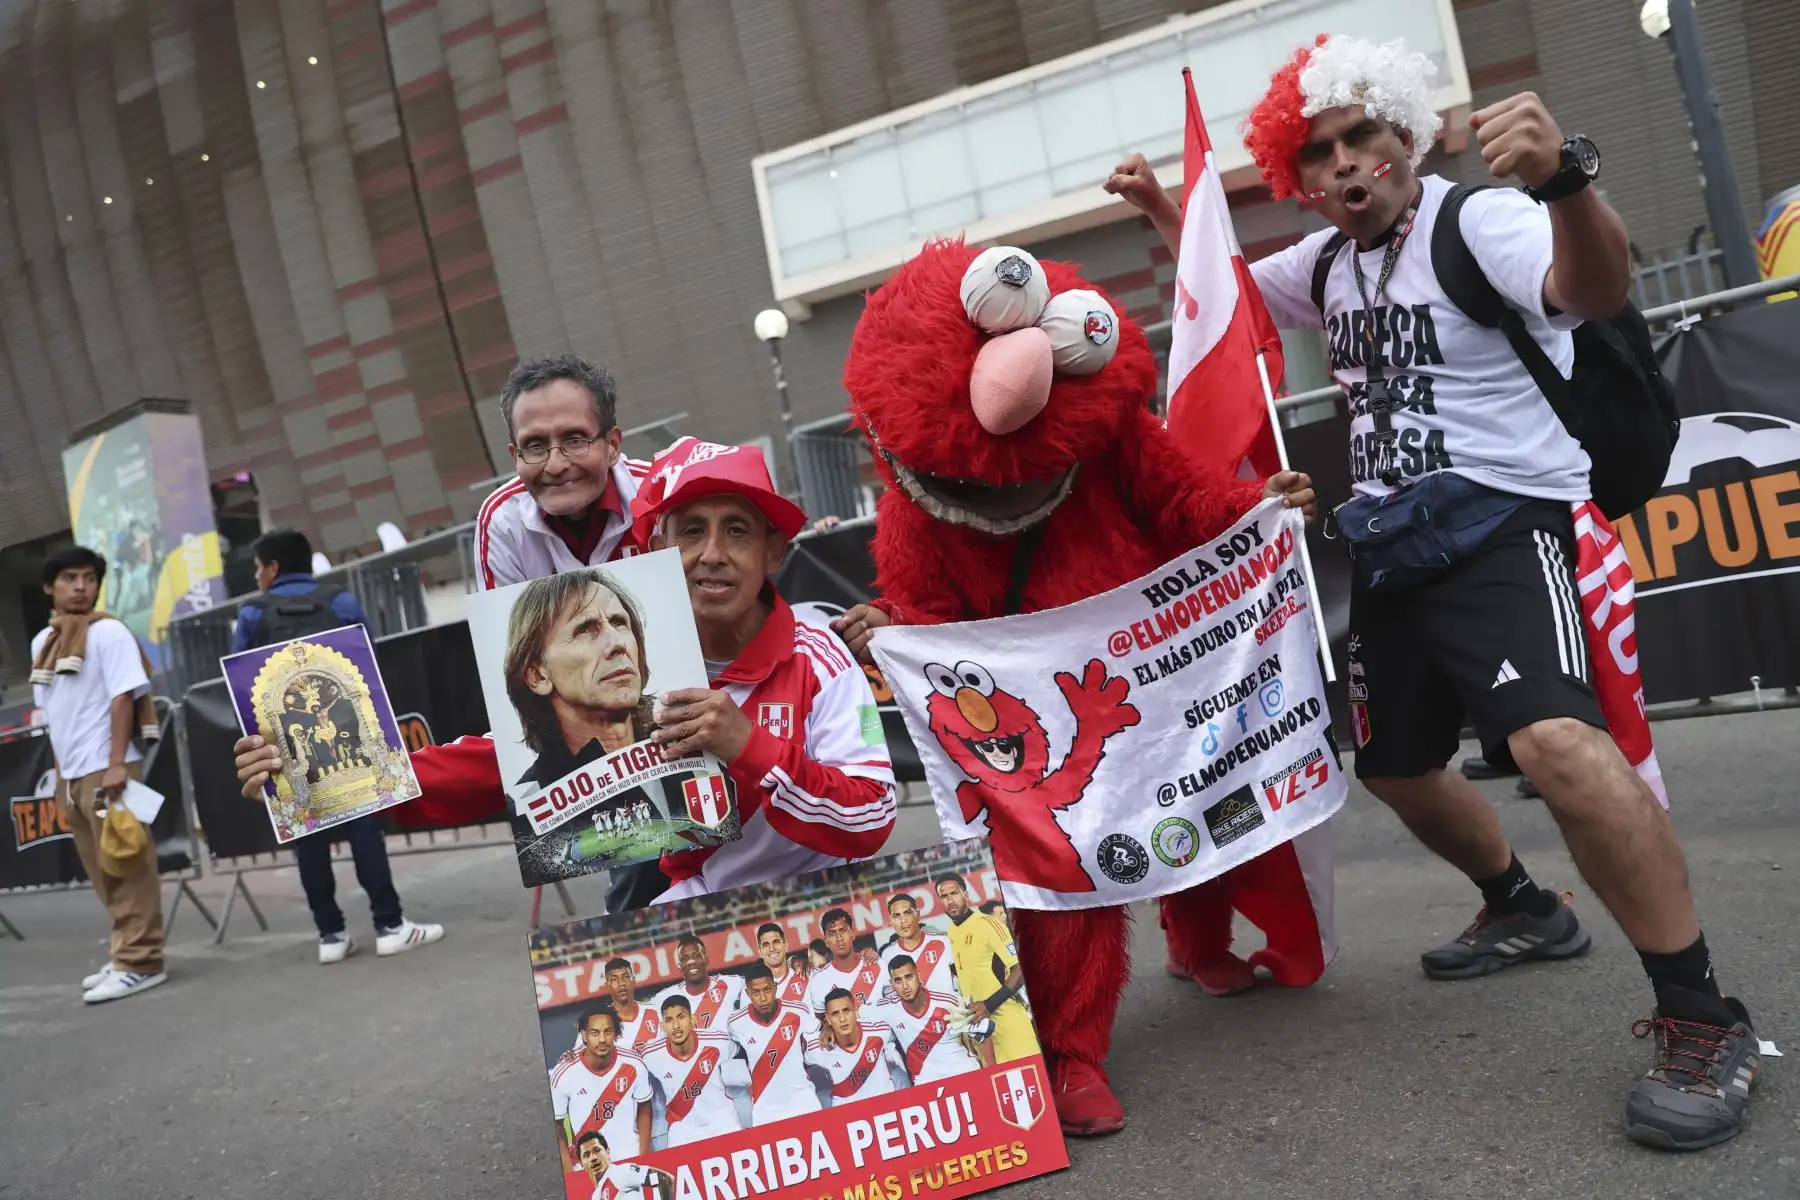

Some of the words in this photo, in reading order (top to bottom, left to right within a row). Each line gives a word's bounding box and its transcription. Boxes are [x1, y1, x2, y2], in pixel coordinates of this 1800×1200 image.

[1350, 428, 1454, 483] GRESA
[1141, 558, 1219, 608] HOLA
[1215, 520, 1264, 567] SOY
[1132, 664, 1158, 687] EL
[1156, 643, 1193, 678] MÁS
[1191, 619, 1237, 659] DURO
[1236, 604, 1258, 634] EN
[1257, 596, 1278, 619] LA
[1184, 672, 1258, 729] SÍGUEME
[1257, 653, 1282, 683] EN
[762, 719, 788, 728] PERU
[549, 772, 595, 811] OJO
[596, 773, 613, 789] DE
[607, 741, 680, 780] TIGR
[564, 802, 586, 817] RICARDO
[585, 791, 607, 805] GARECA
[606, 785, 618, 795] NOS
[618, 779, 631, 789] HIZO
[630, 775, 642, 784] VER
[642, 772, 650, 780] DE
[650, 766, 668, 776] CERCA
[668, 763, 678, 771] UN
[1264, 755, 1329, 812] VES
[1098, 837, 1111, 856] RIDE
[1121, 834, 1140, 850] BIKE
[1211, 821, 1231, 837] BIKE
[1230, 805, 1260, 826] RIDERS
[593, 1099, 615, 1123] 18
[847, 1086, 979, 1169] PERÚ!
[908, 1140, 1029, 1196] FUERTES
